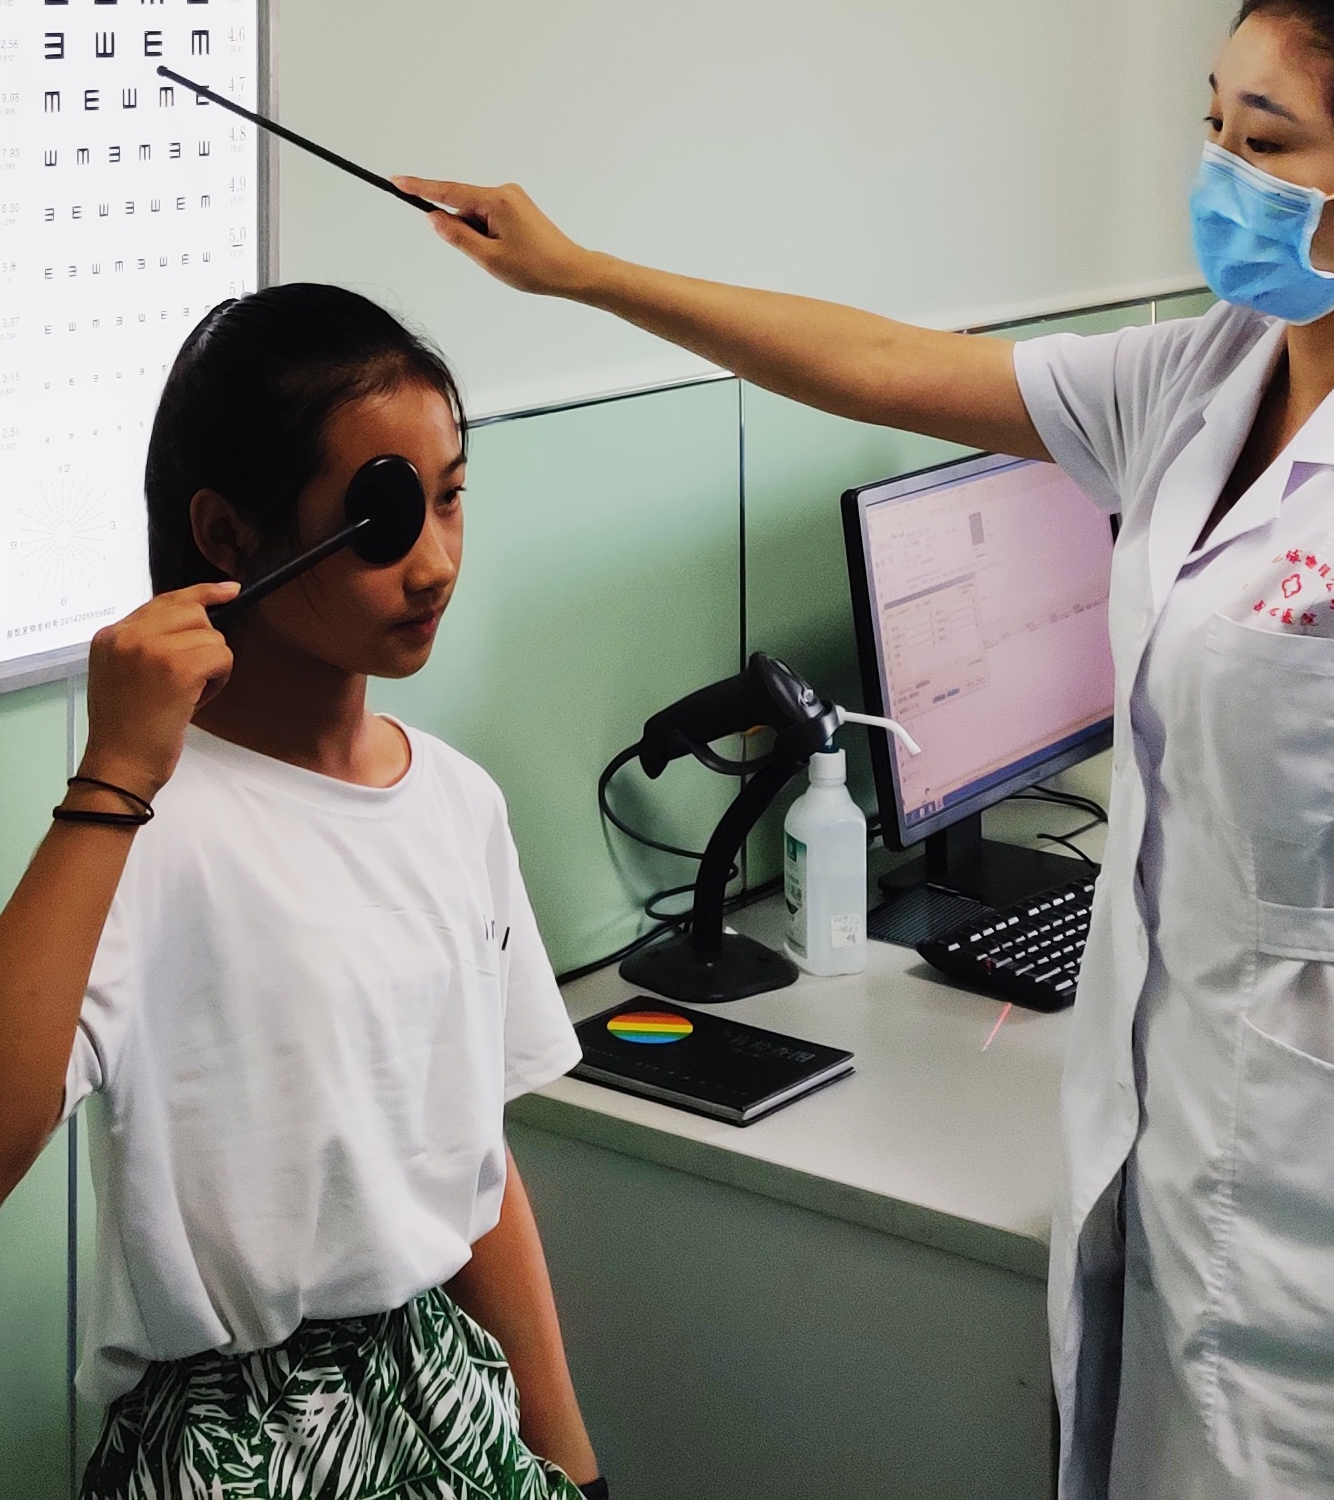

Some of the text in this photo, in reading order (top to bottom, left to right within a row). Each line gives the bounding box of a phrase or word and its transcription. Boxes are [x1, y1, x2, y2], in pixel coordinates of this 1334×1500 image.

[227, 75, 247, 93] 4.7
[228, 125, 247, 142] 4.8
[228, 175, 247, 193] 4.9
[228, 226, 247, 244] 5.0
[57, 463, 71, 474] 12
[10, 540, 18, 551] 9
[60, 596, 68, 607] 6
